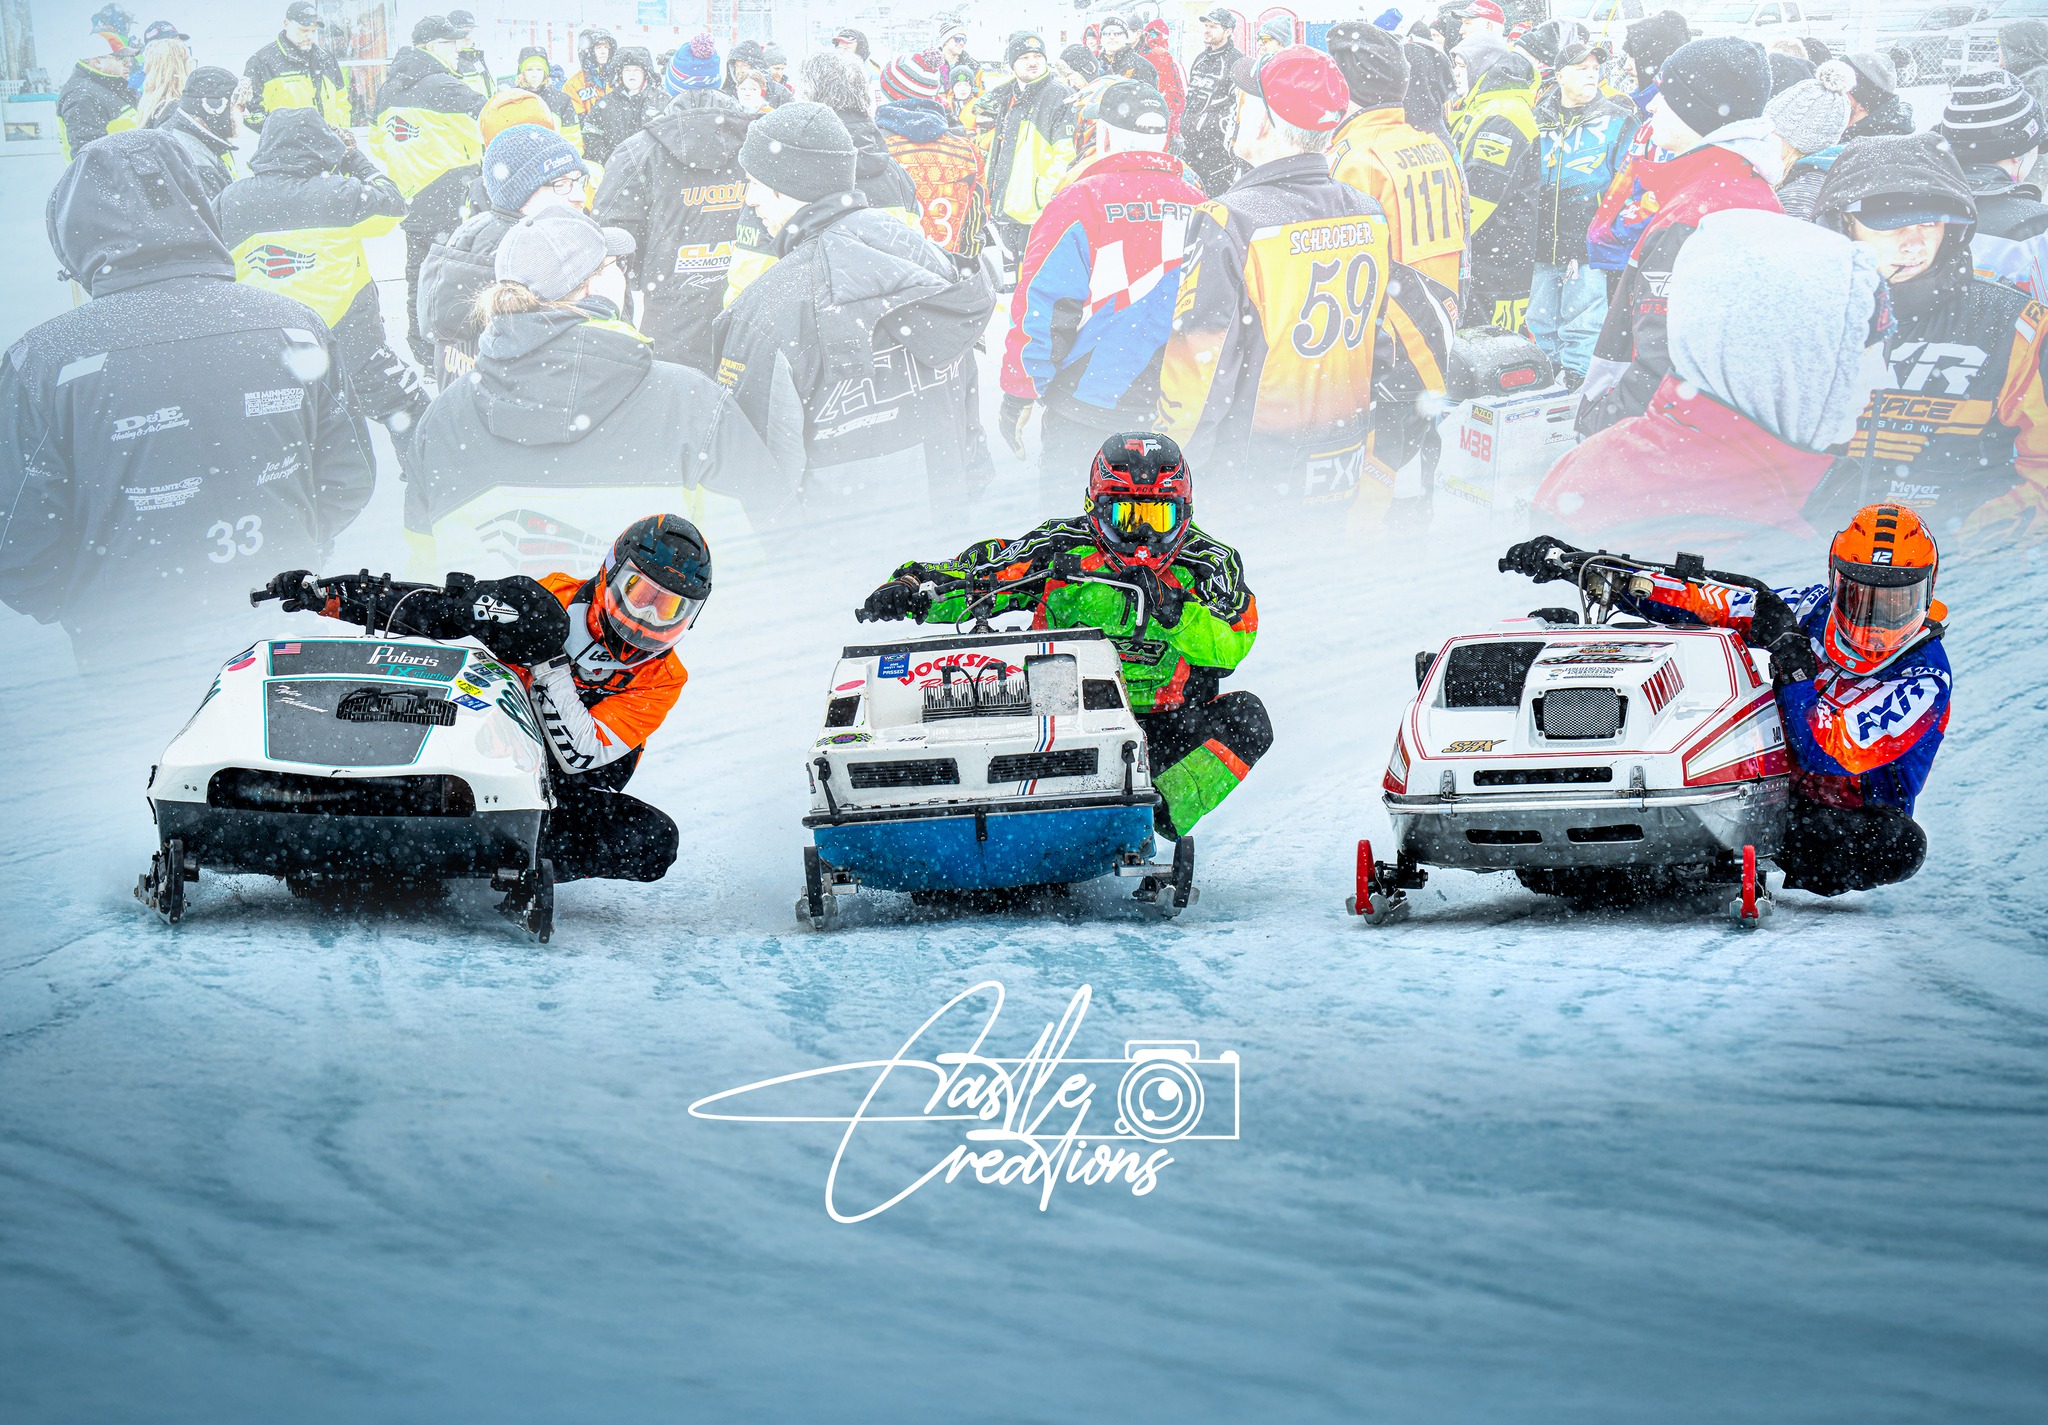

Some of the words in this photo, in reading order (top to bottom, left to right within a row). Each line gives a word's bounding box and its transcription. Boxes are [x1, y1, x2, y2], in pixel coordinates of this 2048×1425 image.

[1394, 142, 1447, 170] JENSEN
[1290, 222, 1374, 254] SCHROEDER
[1291, 252, 1378, 359] 59
[260, 387, 305, 400] MINNESOTA
[113, 405, 184, 434] D&E
[1473, 404, 1494, 420] AZCO
[1459, 426, 1493, 463] M38
[1888, 479, 1942, 500] Meyer
[206, 514, 264, 564] 33
[1872, 551, 1893, 564] 12
[366, 645, 439, 667] Polaris
[379, 663, 427, 679] TX
[1641, 657, 1685, 716] YAMAHA
[1441, 739, 1508, 754] SRX
